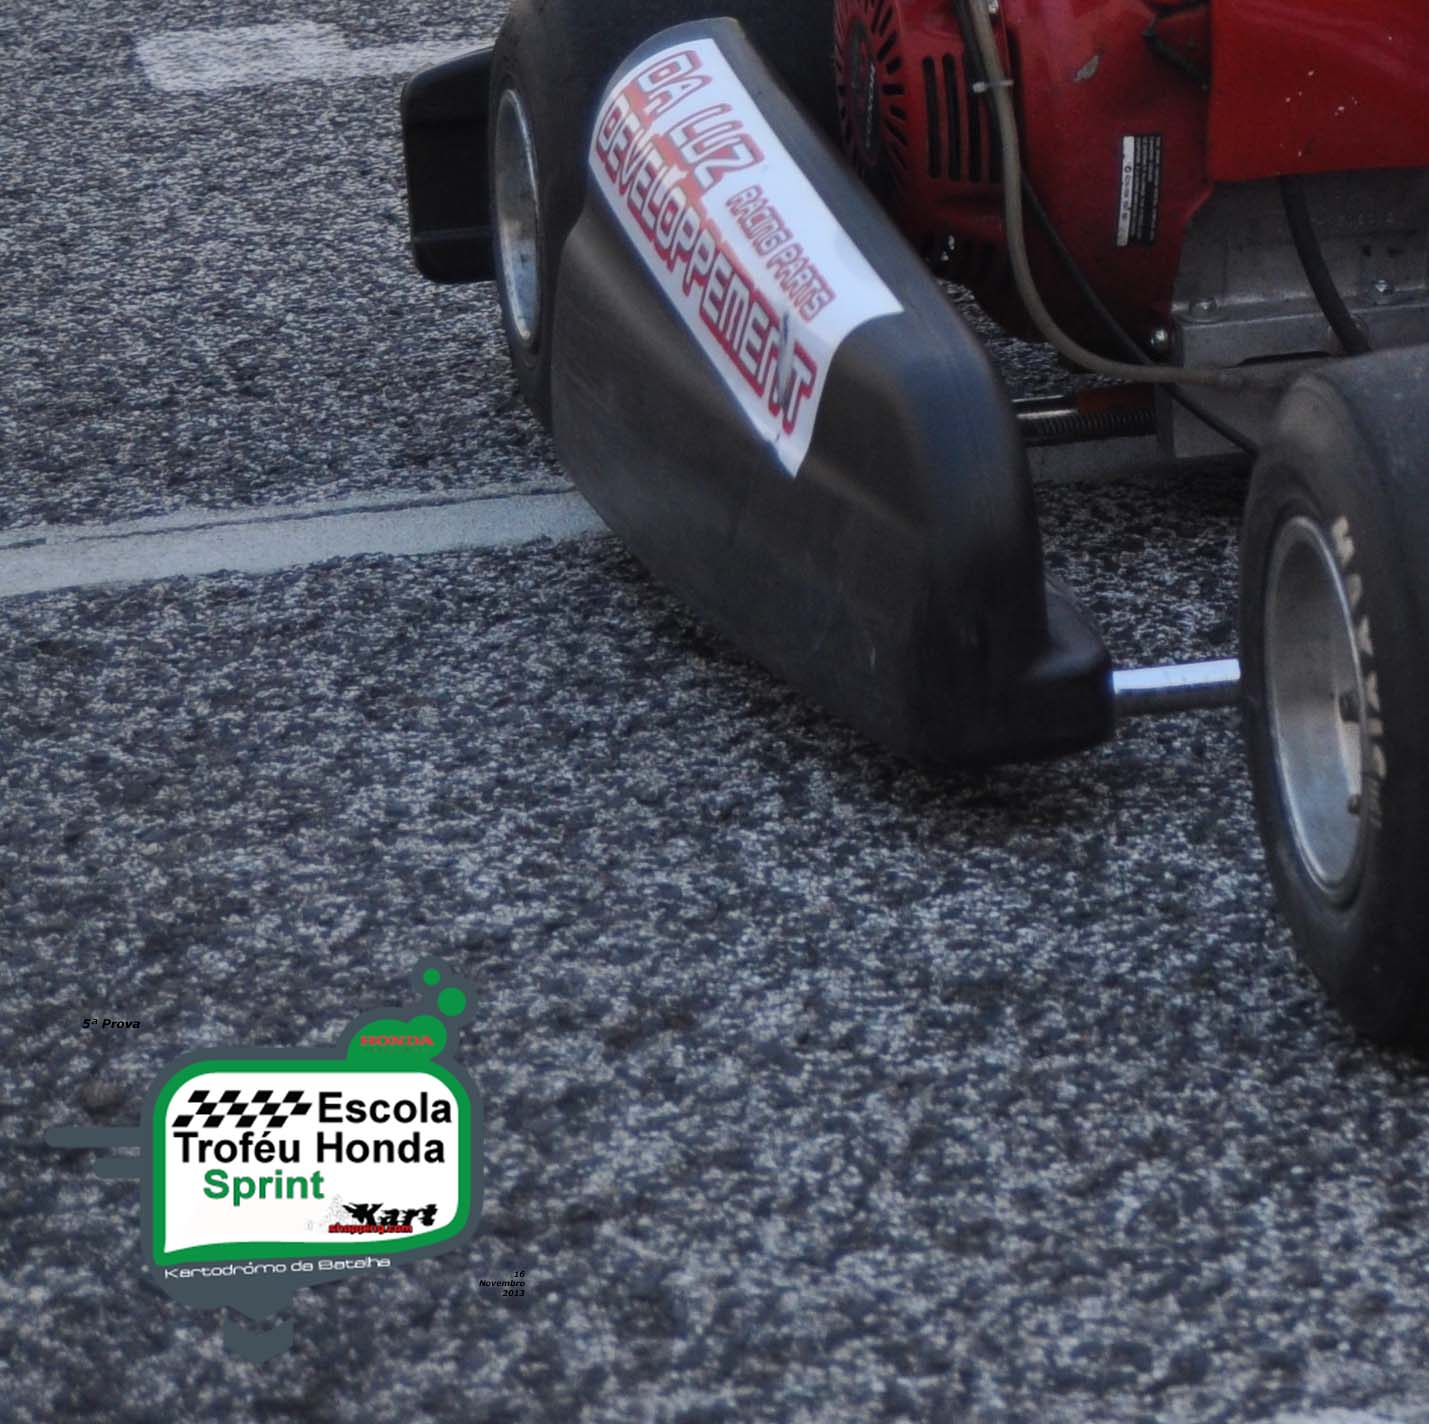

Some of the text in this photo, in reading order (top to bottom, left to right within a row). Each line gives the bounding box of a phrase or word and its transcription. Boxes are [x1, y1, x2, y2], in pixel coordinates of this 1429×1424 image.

[666, 103, 765, 195] LUZ
[596, 95, 818, 435] DEVELOPPEMENT
[726, 184, 838, 324] RACING PARTS
